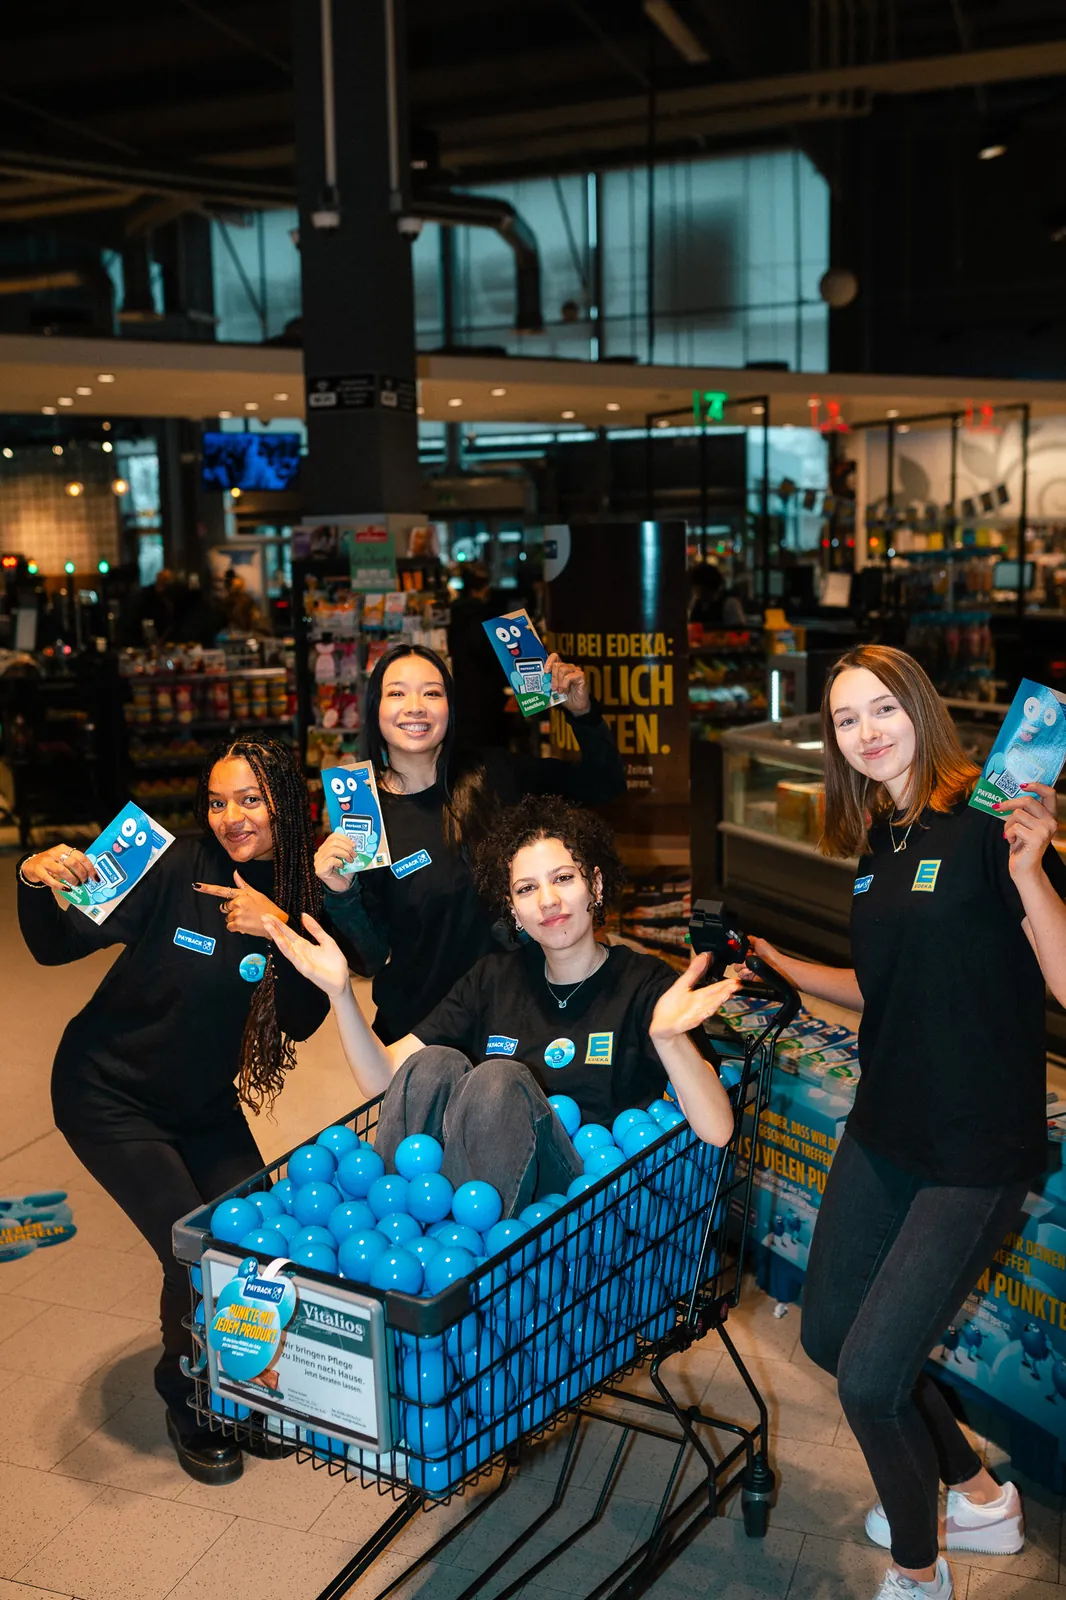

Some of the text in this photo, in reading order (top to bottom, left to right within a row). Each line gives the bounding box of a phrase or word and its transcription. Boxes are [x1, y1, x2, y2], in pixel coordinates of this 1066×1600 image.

[577, 633, 601, 656] BEI
[606, 633, 674, 657] EDEKA:
[580, 664, 674, 707] DLICH
[521, 696, 540, 706] PAYBACK
[524, 700, 546, 712] Anmeldung
[551, 707, 671, 755] PUNEN.
[627, 779, 651, 789] paren.
[977, 788, 1004, 803] PAYBACK
[395, 859, 419, 873] PAYBACK
[177, 934, 203, 947] PAYBACK
[791, 1120, 810, 1139] DASS
[811, 1129, 827, 1149] WIR
[763, 1145, 805, 1185] VIELEN
[1026, 1240, 1065, 1270] DEINEN
[246, 1283, 272, 1295] PAYBACK
[214, 1317, 240, 1335] JEDEM
[227, 1303, 275, 1326] PUNKTE MIT
[302, 1302, 363, 1335] Vitalios
[282, 1352, 365, 1385] zu Ihnen nach Hause.
[296, 1344, 326, 1361] bringen
[328, 1355, 353, 1370] Pflege
[319, 1374, 341, 1387] beraten
